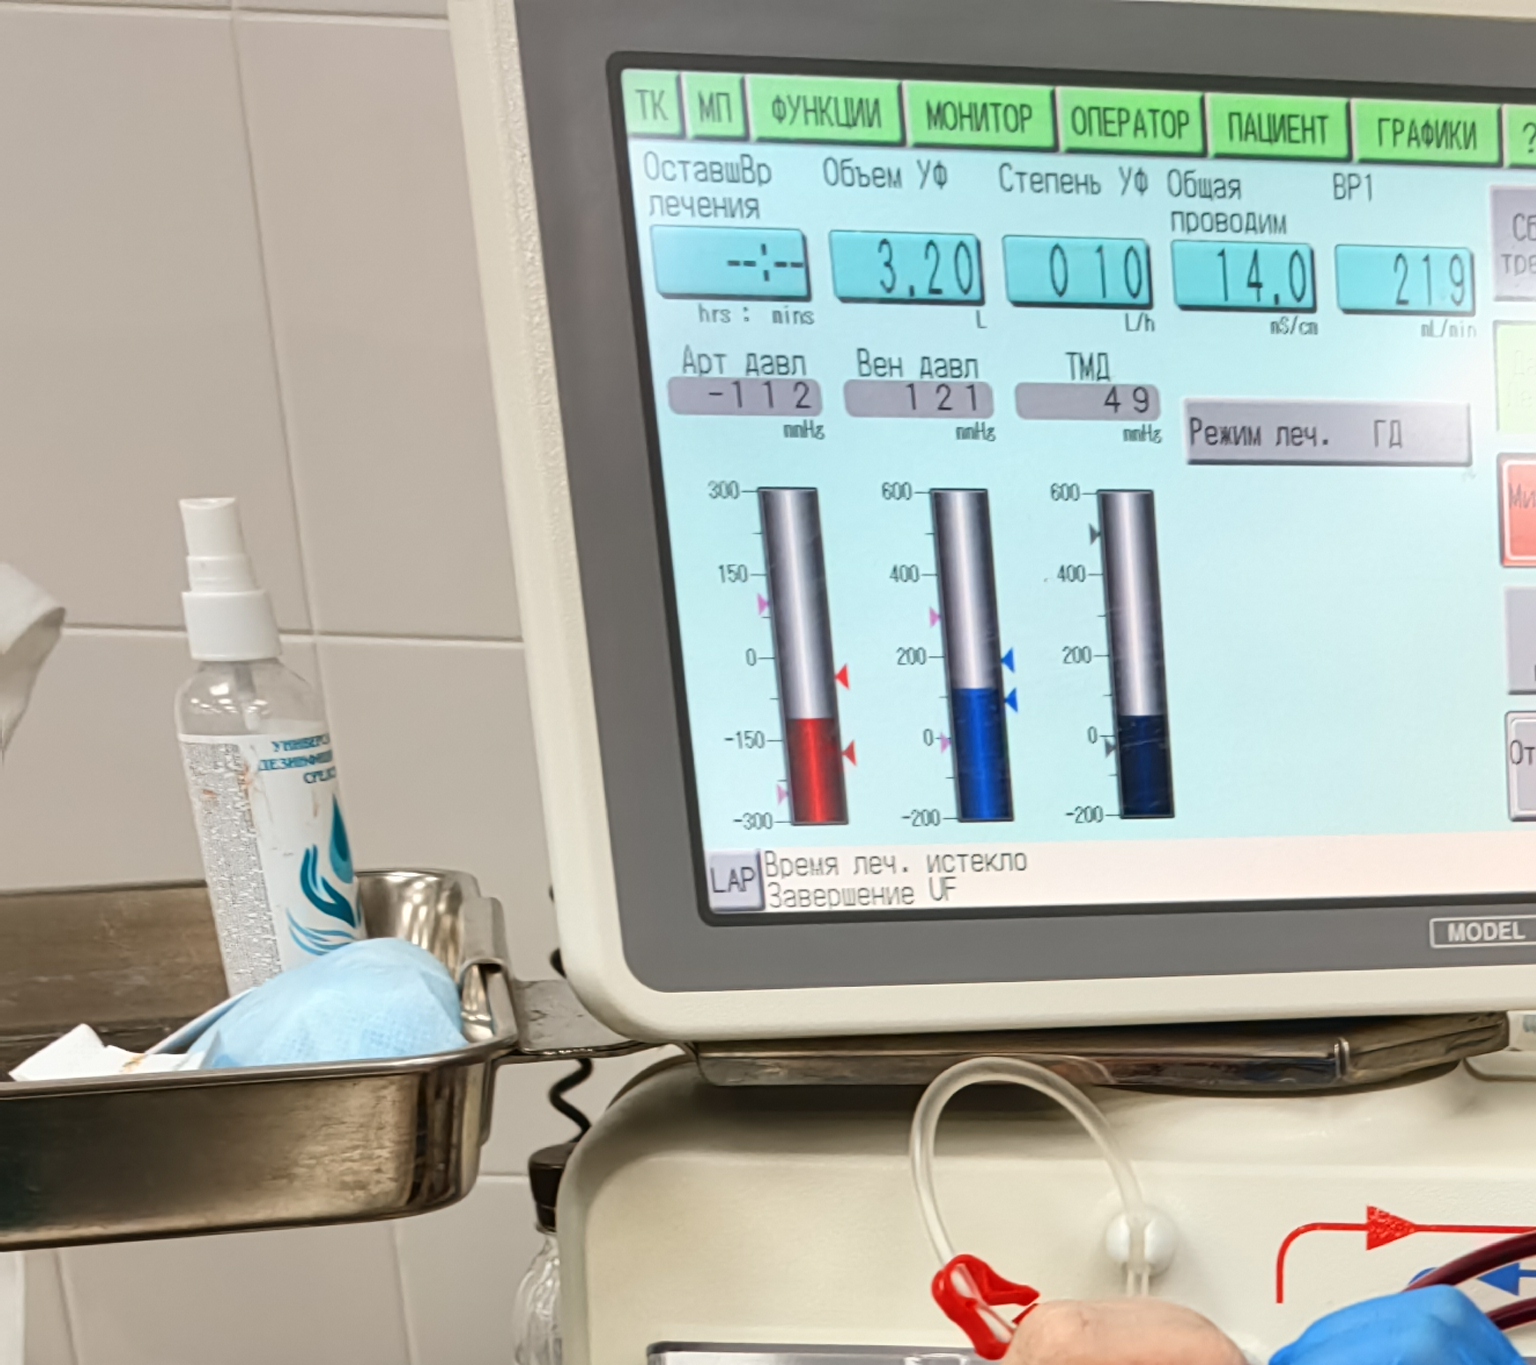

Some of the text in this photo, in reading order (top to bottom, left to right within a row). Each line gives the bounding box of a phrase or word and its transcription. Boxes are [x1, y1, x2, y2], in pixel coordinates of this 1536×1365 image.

[635, 90, 669, 121] ТК
[698, 93, 732, 124] МП
[772, 96, 882, 129] ФУНКЦИИ
[926, 100, 1033, 133] МОНИТОР
[1071, 106, 1190, 138] ОПЕРАТОР
[1227, 111, 1328, 145] ПАЦИЕНТ
[1378, 118, 1478, 151] ГРАФИКИ
[823, 158, 948, 188] Объем УФ
[999, 163, 1149, 197] Степень УФ
[1167, 169, 1241, 200] Общая
[649, 195, 761, 220] лечения
[1170, 211, 1288, 235] проводим
[877, 237, 975, 298] 3.20
[1217, 247, 1308, 304] 14.0
[1394, 252, 1467, 306] 219
[698, 303, 731, 324] hrs
[977, 312, 988, 329] L
[1124, 312, 1155, 332] L/h
[682, 344, 807, 378] Арт давл
[857, 348, 979, 379] Вен давл
[1066, 352, 1111, 380] ТМД
[708, 380, 812, 409] -112
[905, 382, 979, 411] 121
[1103, 385, 1150, 414] 49
[1189, 417, 1404, 447] Режим леч. ГД
[708, 480, 740, 499] 300
[882, 481, 913, 501] 600
[1051, 483, 1081, 502] 600
[719, 564, 748, 584] 150
[889, 565, 920, 584] 400
[1057, 565, 1086, 584] 400
[745, 648, 757, 667] 0
[897, 647, 927, 666] 200
[1063, 646, 1092, 665] 200
[724, 731, 766, 750] -150
[923, 729, 933, 747] 0
[1088, 727, 1097, 745] 0
[733, 812, 774, 831] -300
[901, 809, 942, 828] -200
[1065, 806, 1104, 825] -200
[764, 850, 1028, 879] Время леч. истекло
[710, 866, 757, 895] LAP
[767, 878, 957, 911] Завершение UF
[1448, 922, 1526, 941] MODEL
